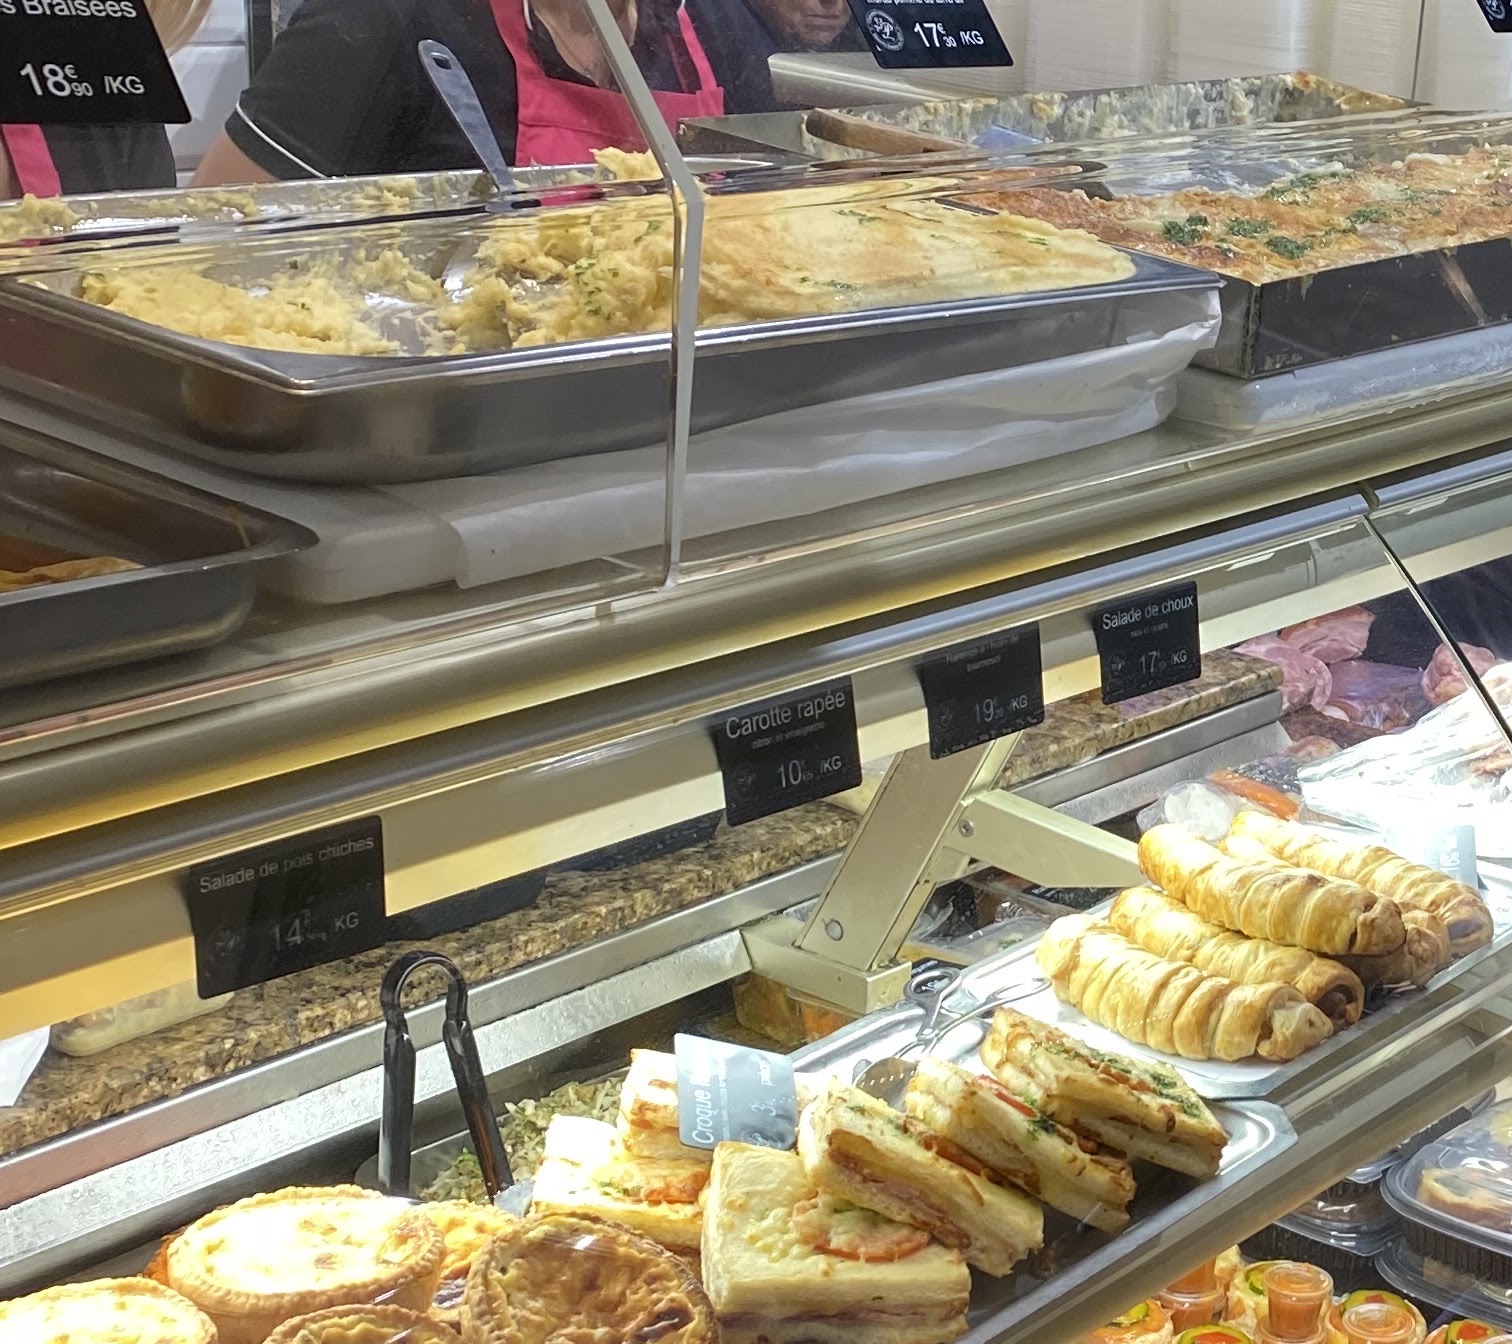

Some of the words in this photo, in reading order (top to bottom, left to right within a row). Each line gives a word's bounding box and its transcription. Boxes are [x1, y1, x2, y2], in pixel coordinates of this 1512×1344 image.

[1102, 606, 1142, 630] Salade
[1144, 601, 1159, 619] de
[1161, 594, 1195, 615] choux
[726, 706, 792, 739] Carotte
[199, 867, 256, 895] Salade
[258, 861, 279, 878] de
[691, 1089, 719, 1144] Croque
